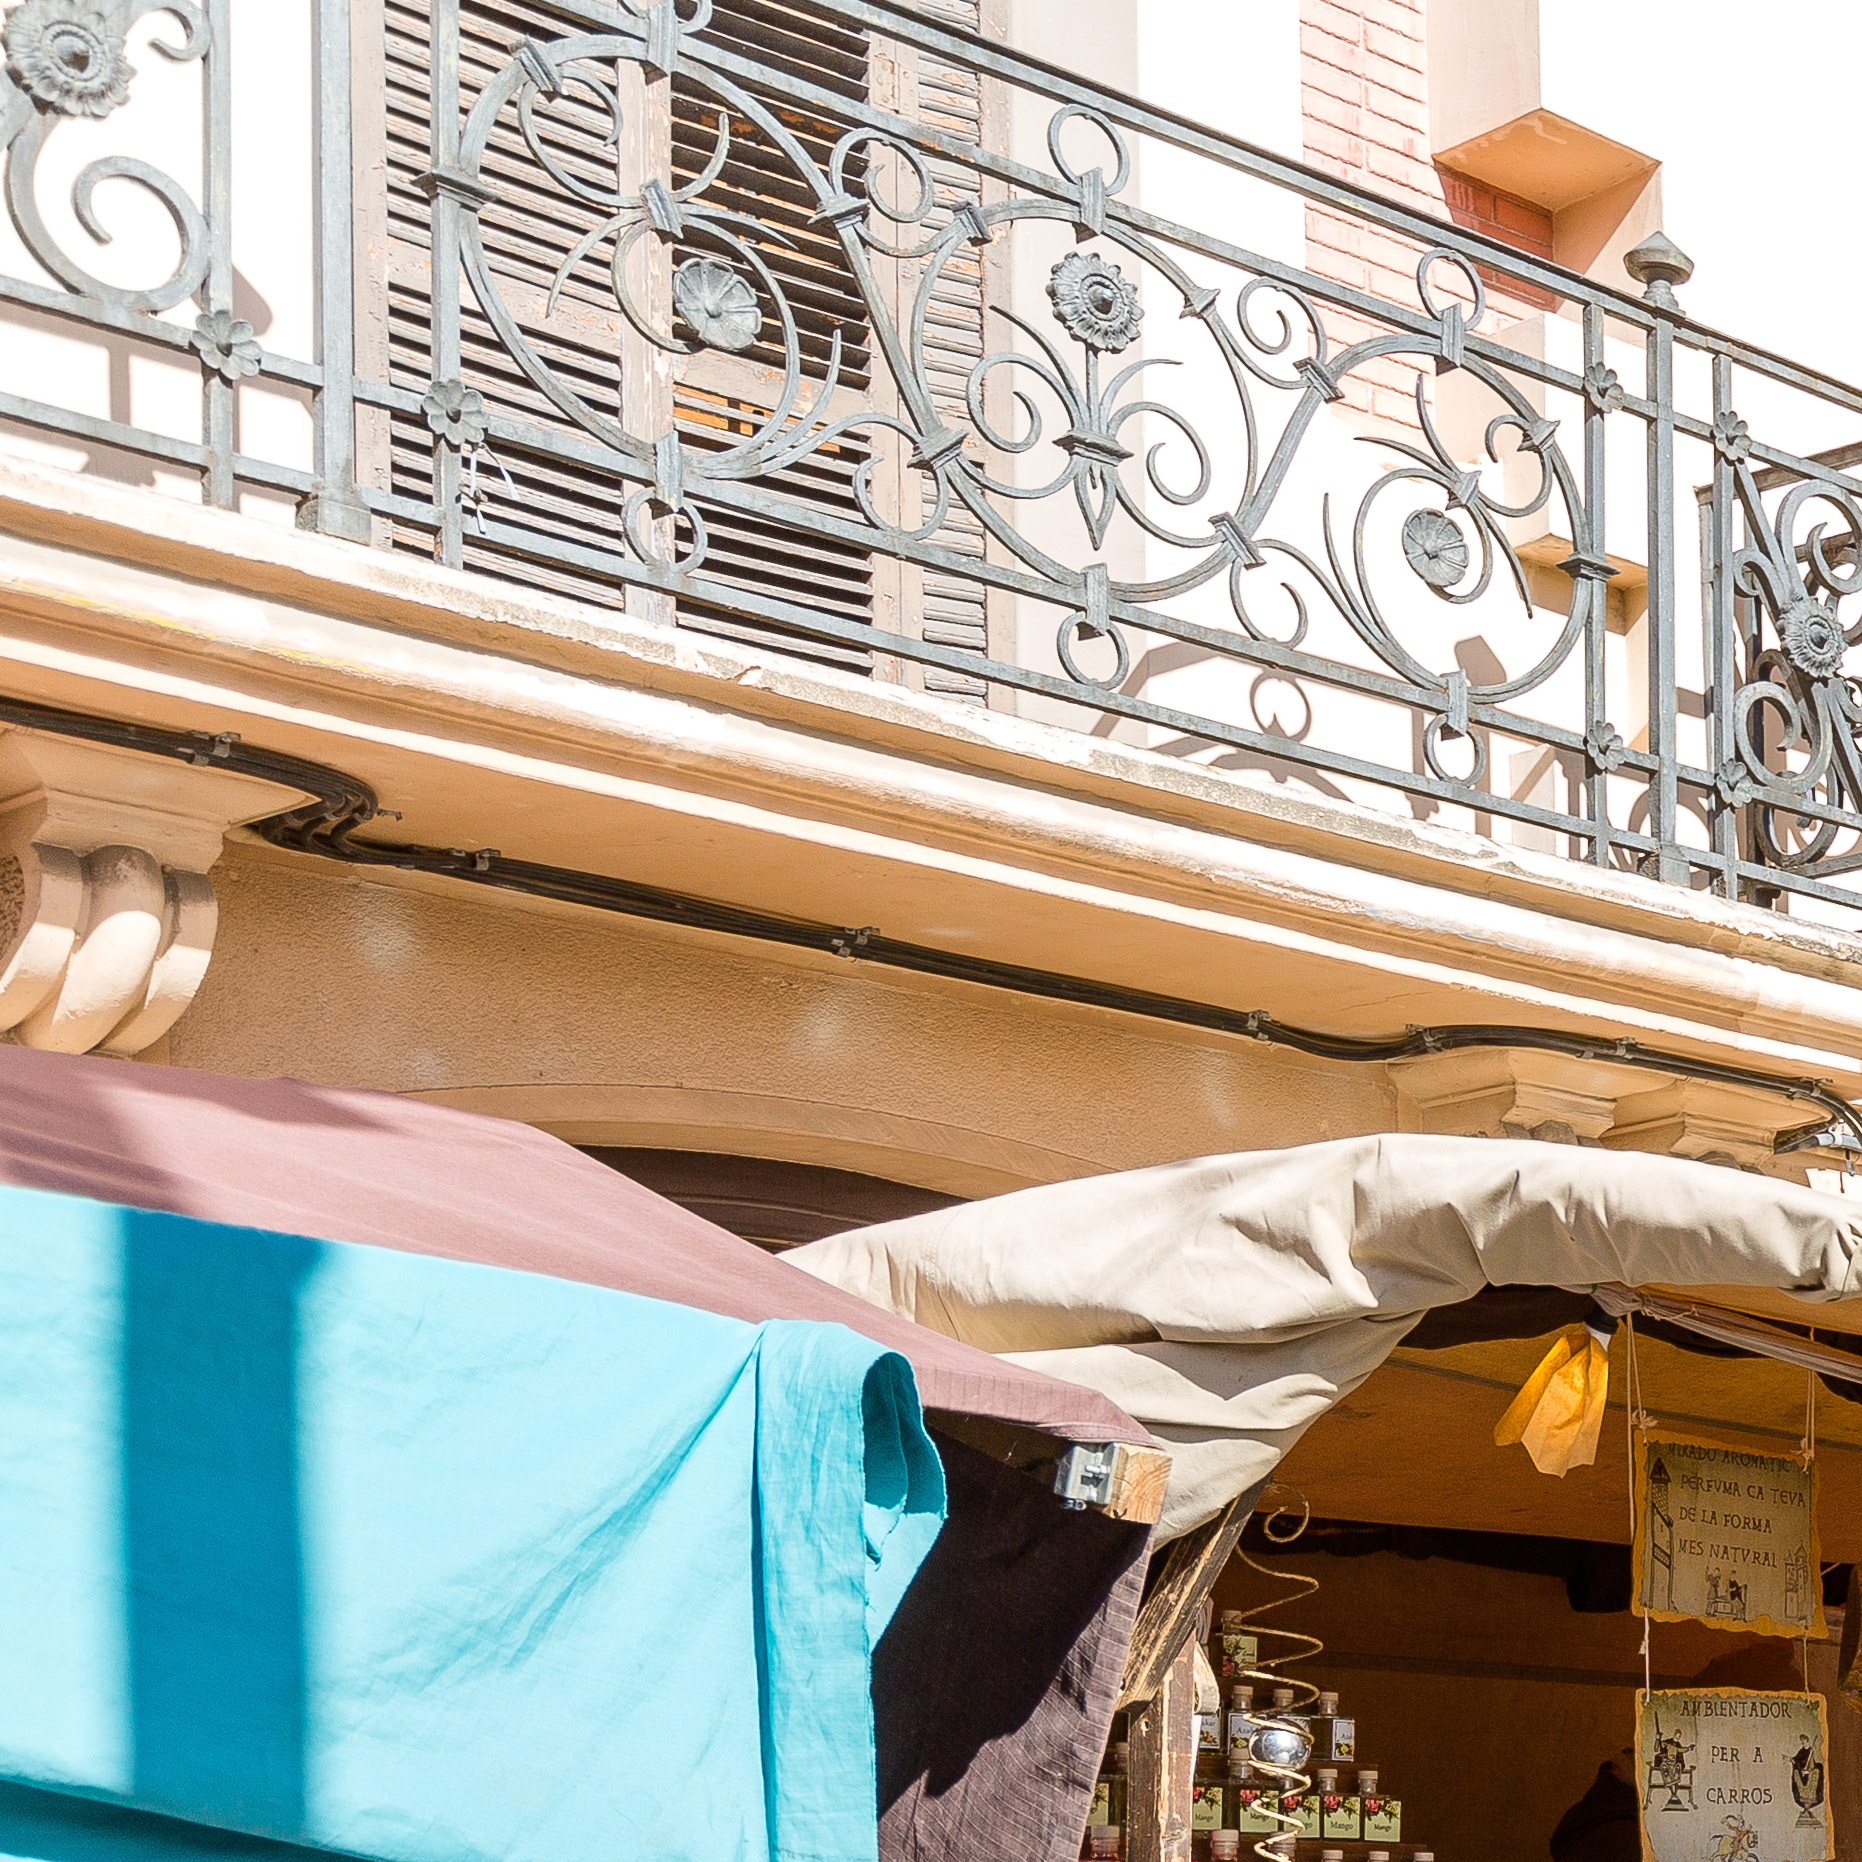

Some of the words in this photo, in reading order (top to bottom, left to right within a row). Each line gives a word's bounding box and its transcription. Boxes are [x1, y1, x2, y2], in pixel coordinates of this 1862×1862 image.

[1722, 1451, 1790, 1473] AROMATIC
[1746, 1484, 1765, 1501] CA
[1770, 1488, 1807, 1509] TEVA
[1679, 1506, 1697, 1522] DE
[1701, 1509, 1718, 1526] LA
[1723, 1513, 1773, 1535] FORMA
[1678, 1537, 1705, 1557] MES
[1679, 1700, 1792, 1719] AMBIENTADOR
[1711, 1745, 1741, 1764] PER
[1752, 1746, 1764, 1764] A
[1706, 1787, 1773, 1805] CARROS
[1330, 1820, 1354, 1831] Mango
